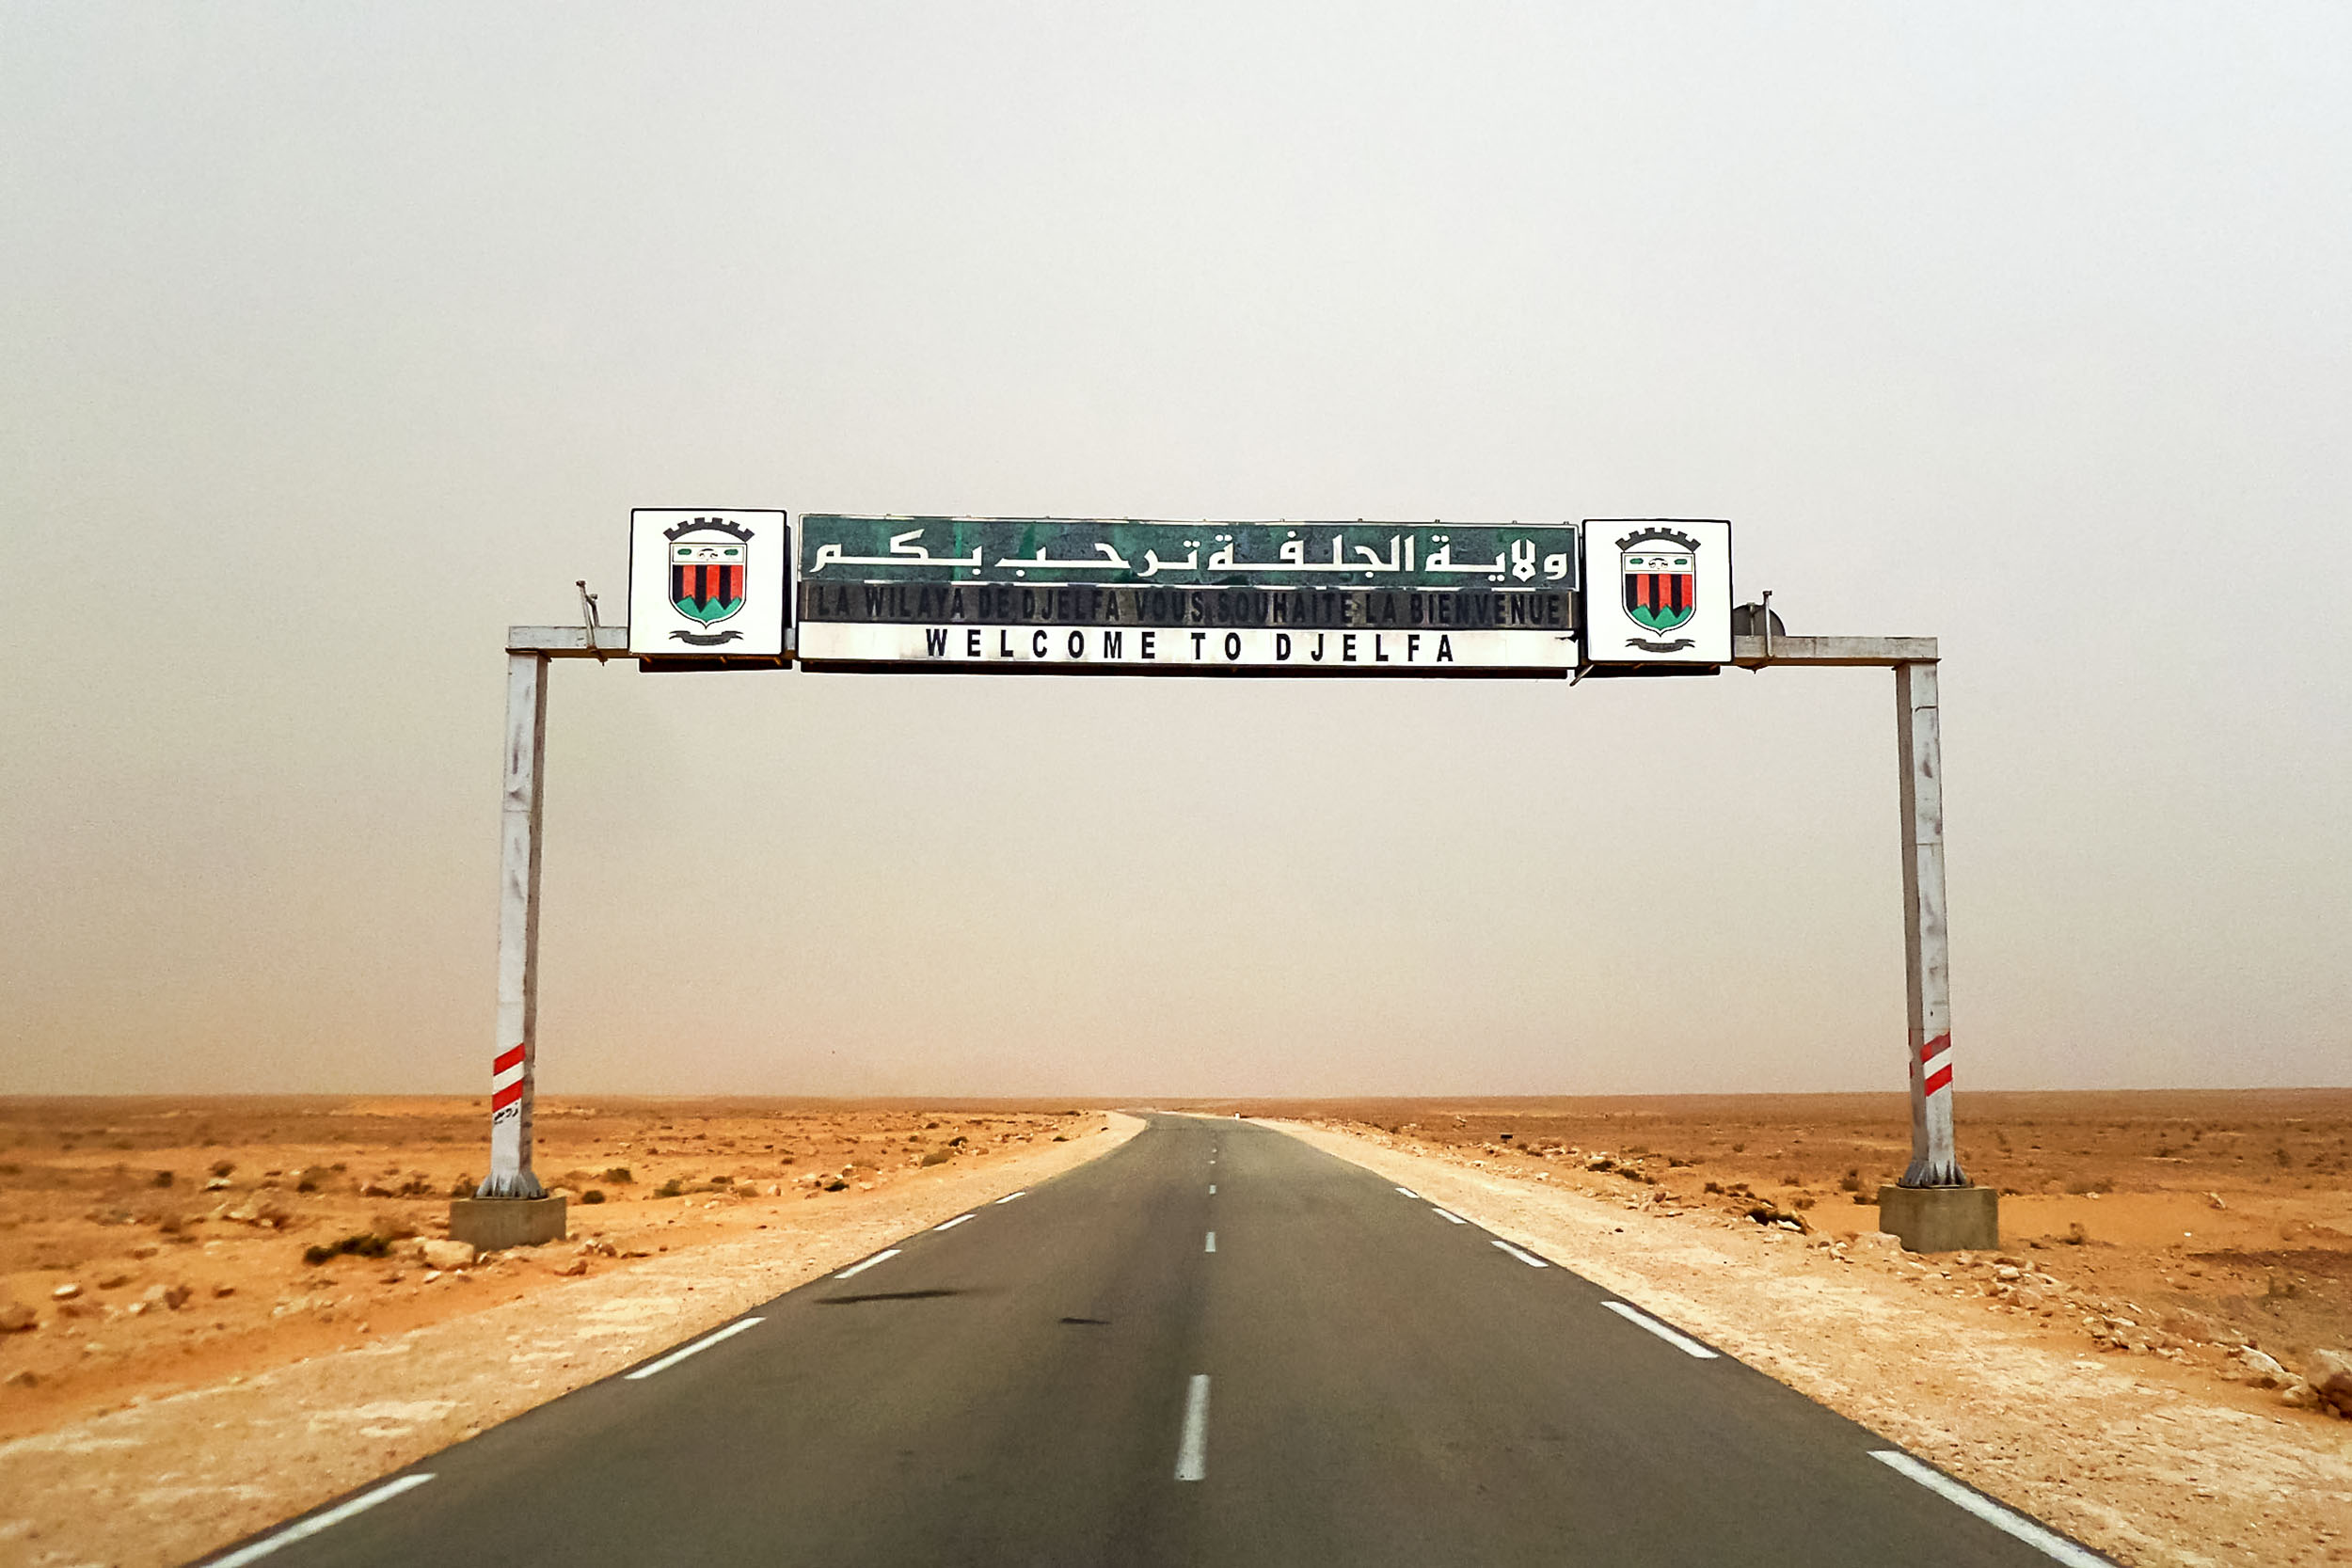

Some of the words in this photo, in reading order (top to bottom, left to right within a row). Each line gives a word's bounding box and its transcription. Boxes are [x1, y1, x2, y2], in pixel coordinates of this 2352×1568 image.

[809, 528, 982, 576] بكم
[994, 540, 1200, 577] ترحب
[1207, 530, 1415, 578] الجلفة
[1424, 534, 1567, 582] ولاية
[819, 584, 850, 617] LA
[865, 585, 965, 620] WILAYA
[978, 588, 1010, 620] DE
[1022, 588, 1120, 622] DJELFA
[1135, 590, 1203, 623] VOUS
[1218, 591, 1355, 625] SOUHAITE
[1365, 593, 1397, 625] LA
[1411, 593, 1560, 626] BIENVENUE
[926, 628, 1155, 659] WELCOME
[1191, 632, 1242, 660] TO
[1276, 633, 1454, 662] DJELFA
